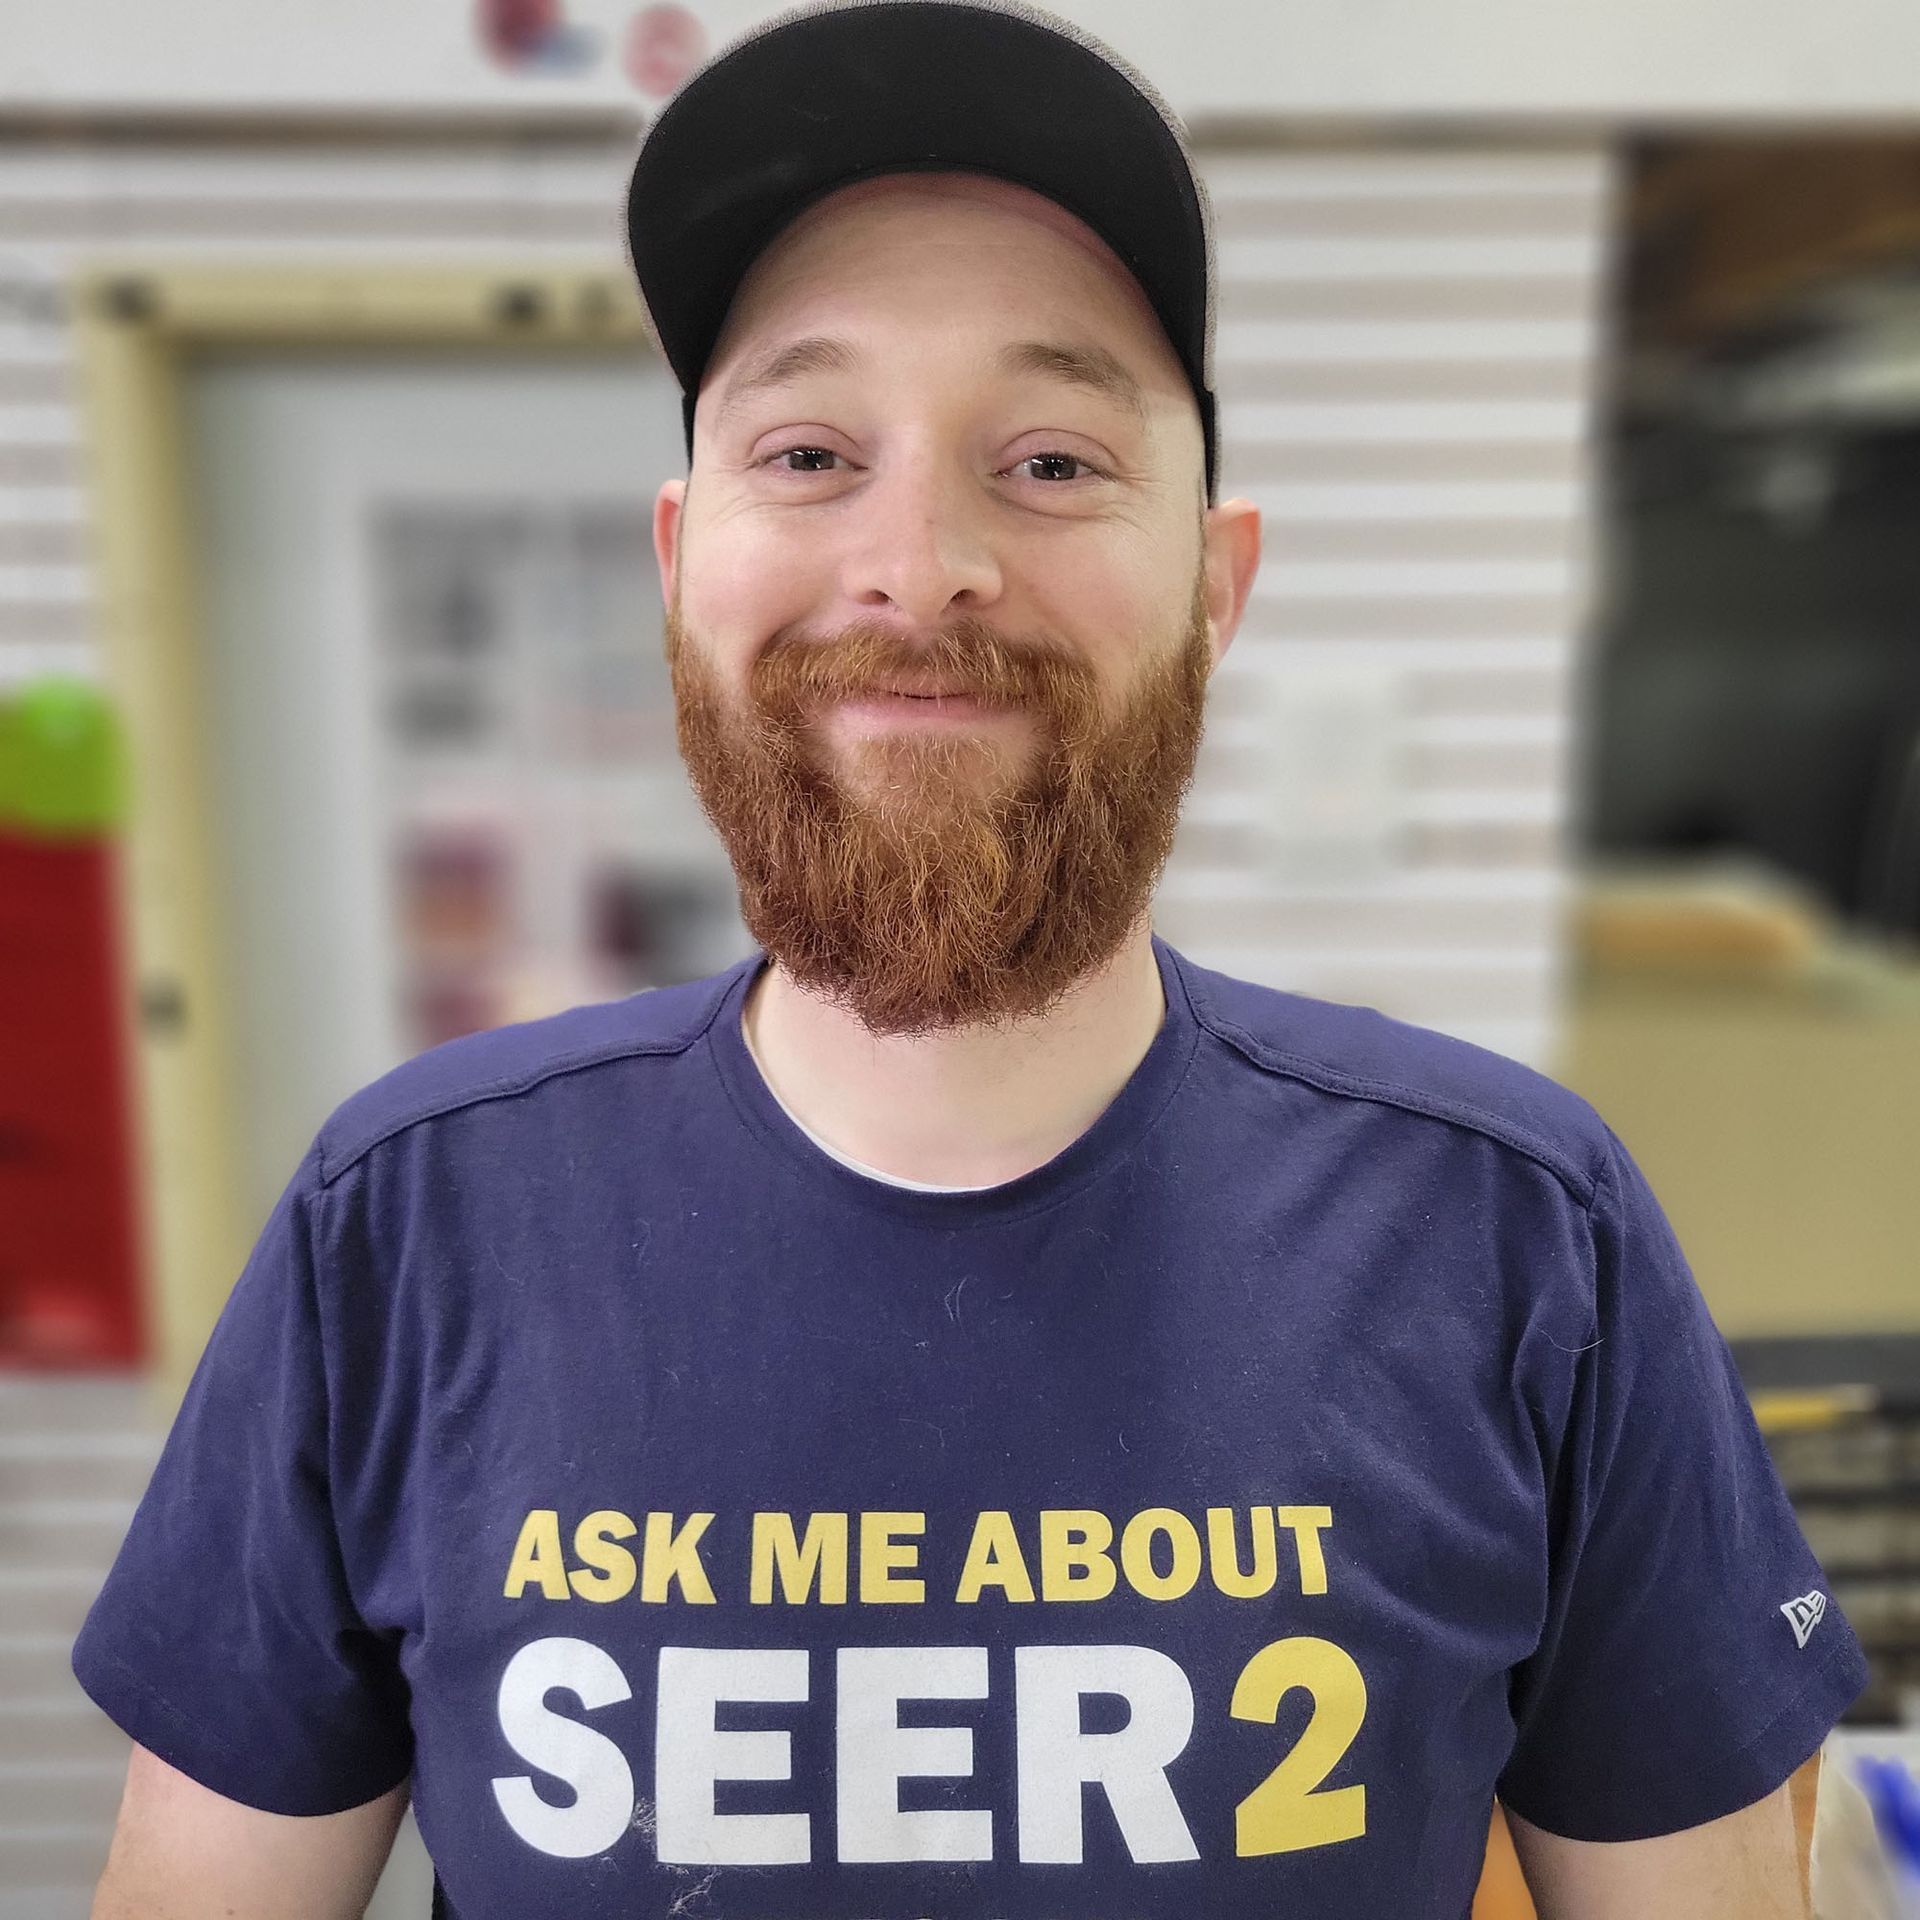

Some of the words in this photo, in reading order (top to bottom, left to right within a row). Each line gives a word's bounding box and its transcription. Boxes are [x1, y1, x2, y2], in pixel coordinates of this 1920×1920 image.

[504, 1509, 717, 1605] ASK
[750, 1512, 926, 1605] ME
[955, 1505, 1333, 1603] ABOUT
